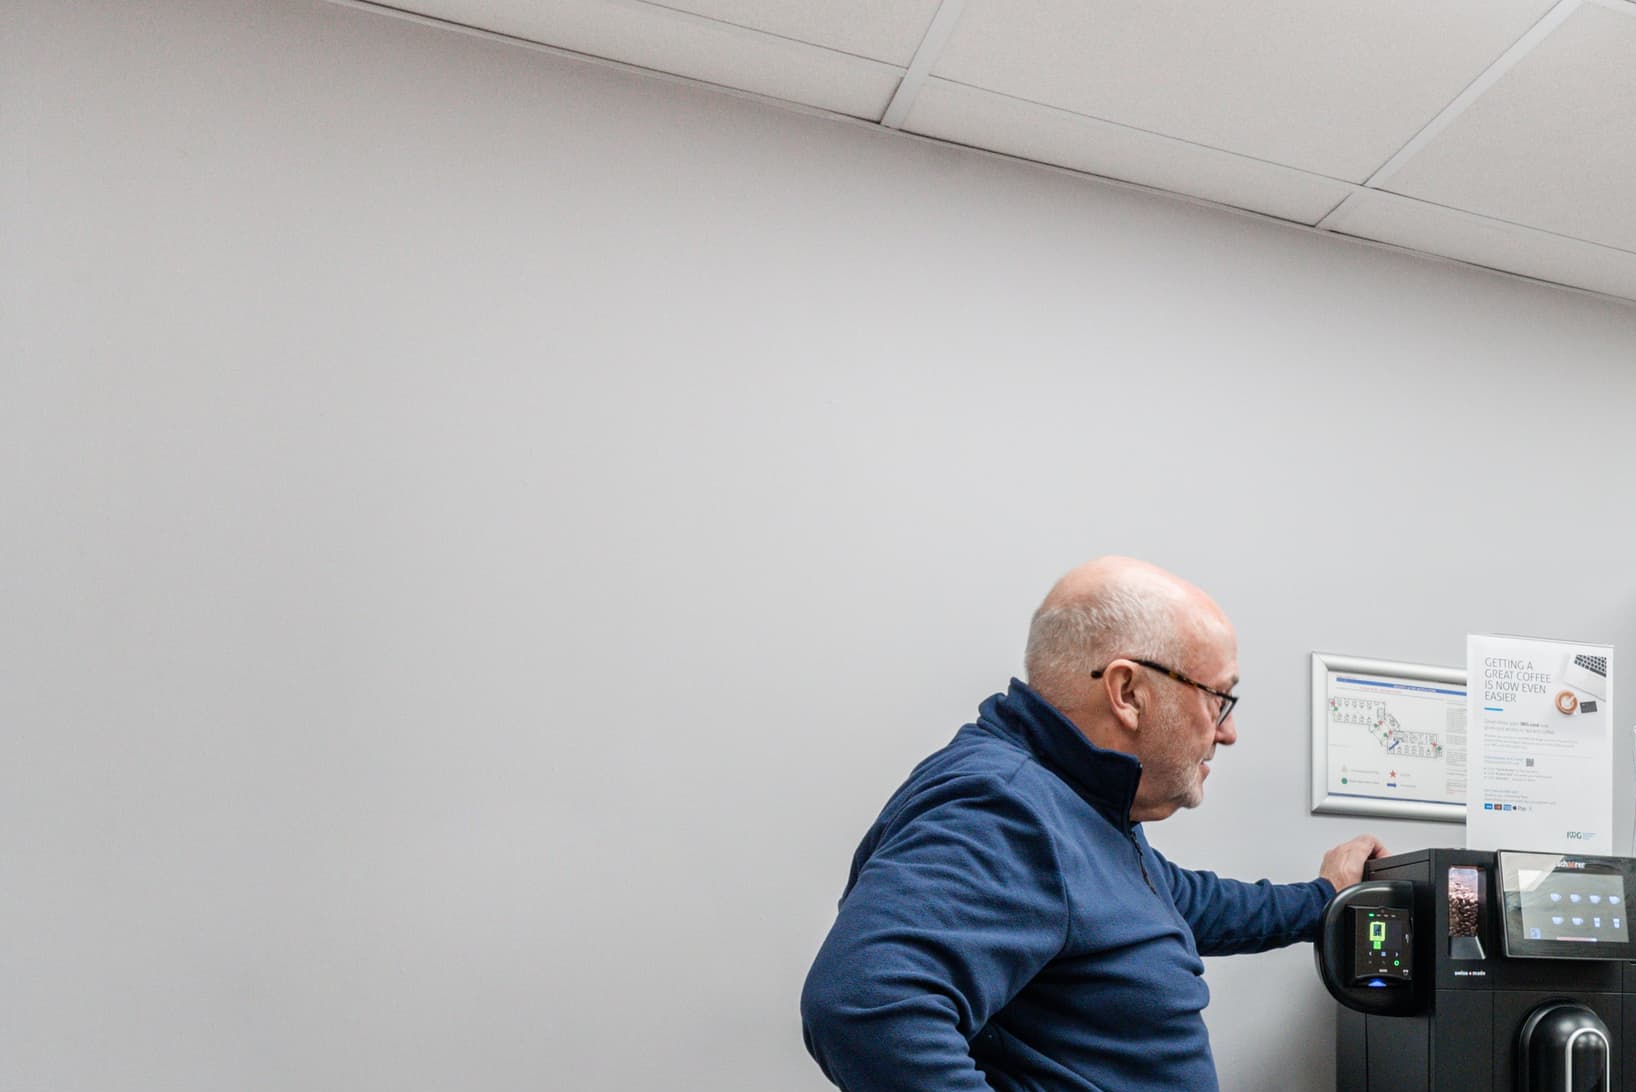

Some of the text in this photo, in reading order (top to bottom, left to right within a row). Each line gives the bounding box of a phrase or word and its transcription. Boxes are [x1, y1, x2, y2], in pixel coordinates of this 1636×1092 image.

[1484, 657, 1533, 670] GETTING A
[1484, 669, 1551, 683] GREAT COFFEE
[1484, 680, 1546, 694] IS NOW EVEN
[1484, 691, 1517, 703] EASIER
